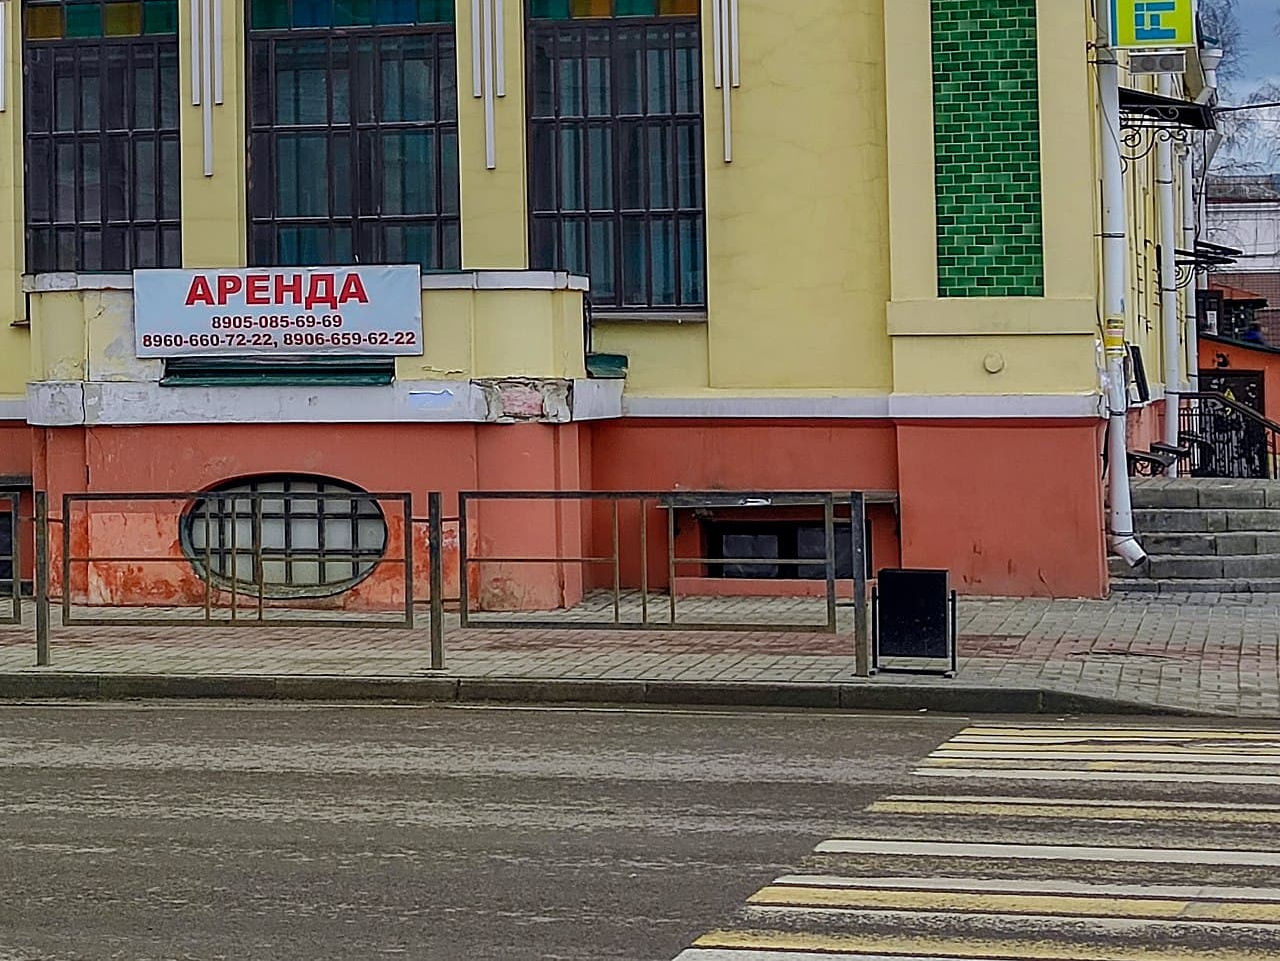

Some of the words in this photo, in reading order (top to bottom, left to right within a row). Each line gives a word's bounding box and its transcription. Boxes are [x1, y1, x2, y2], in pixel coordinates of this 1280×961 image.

[185, 273, 369, 310] АРЕНДА
[211, 314, 343, 330] 8905-085-69-69
[142, 333, 278, 348] 8960-660-72-22,
[283, 332, 416, 346] 8906-659-62-22
